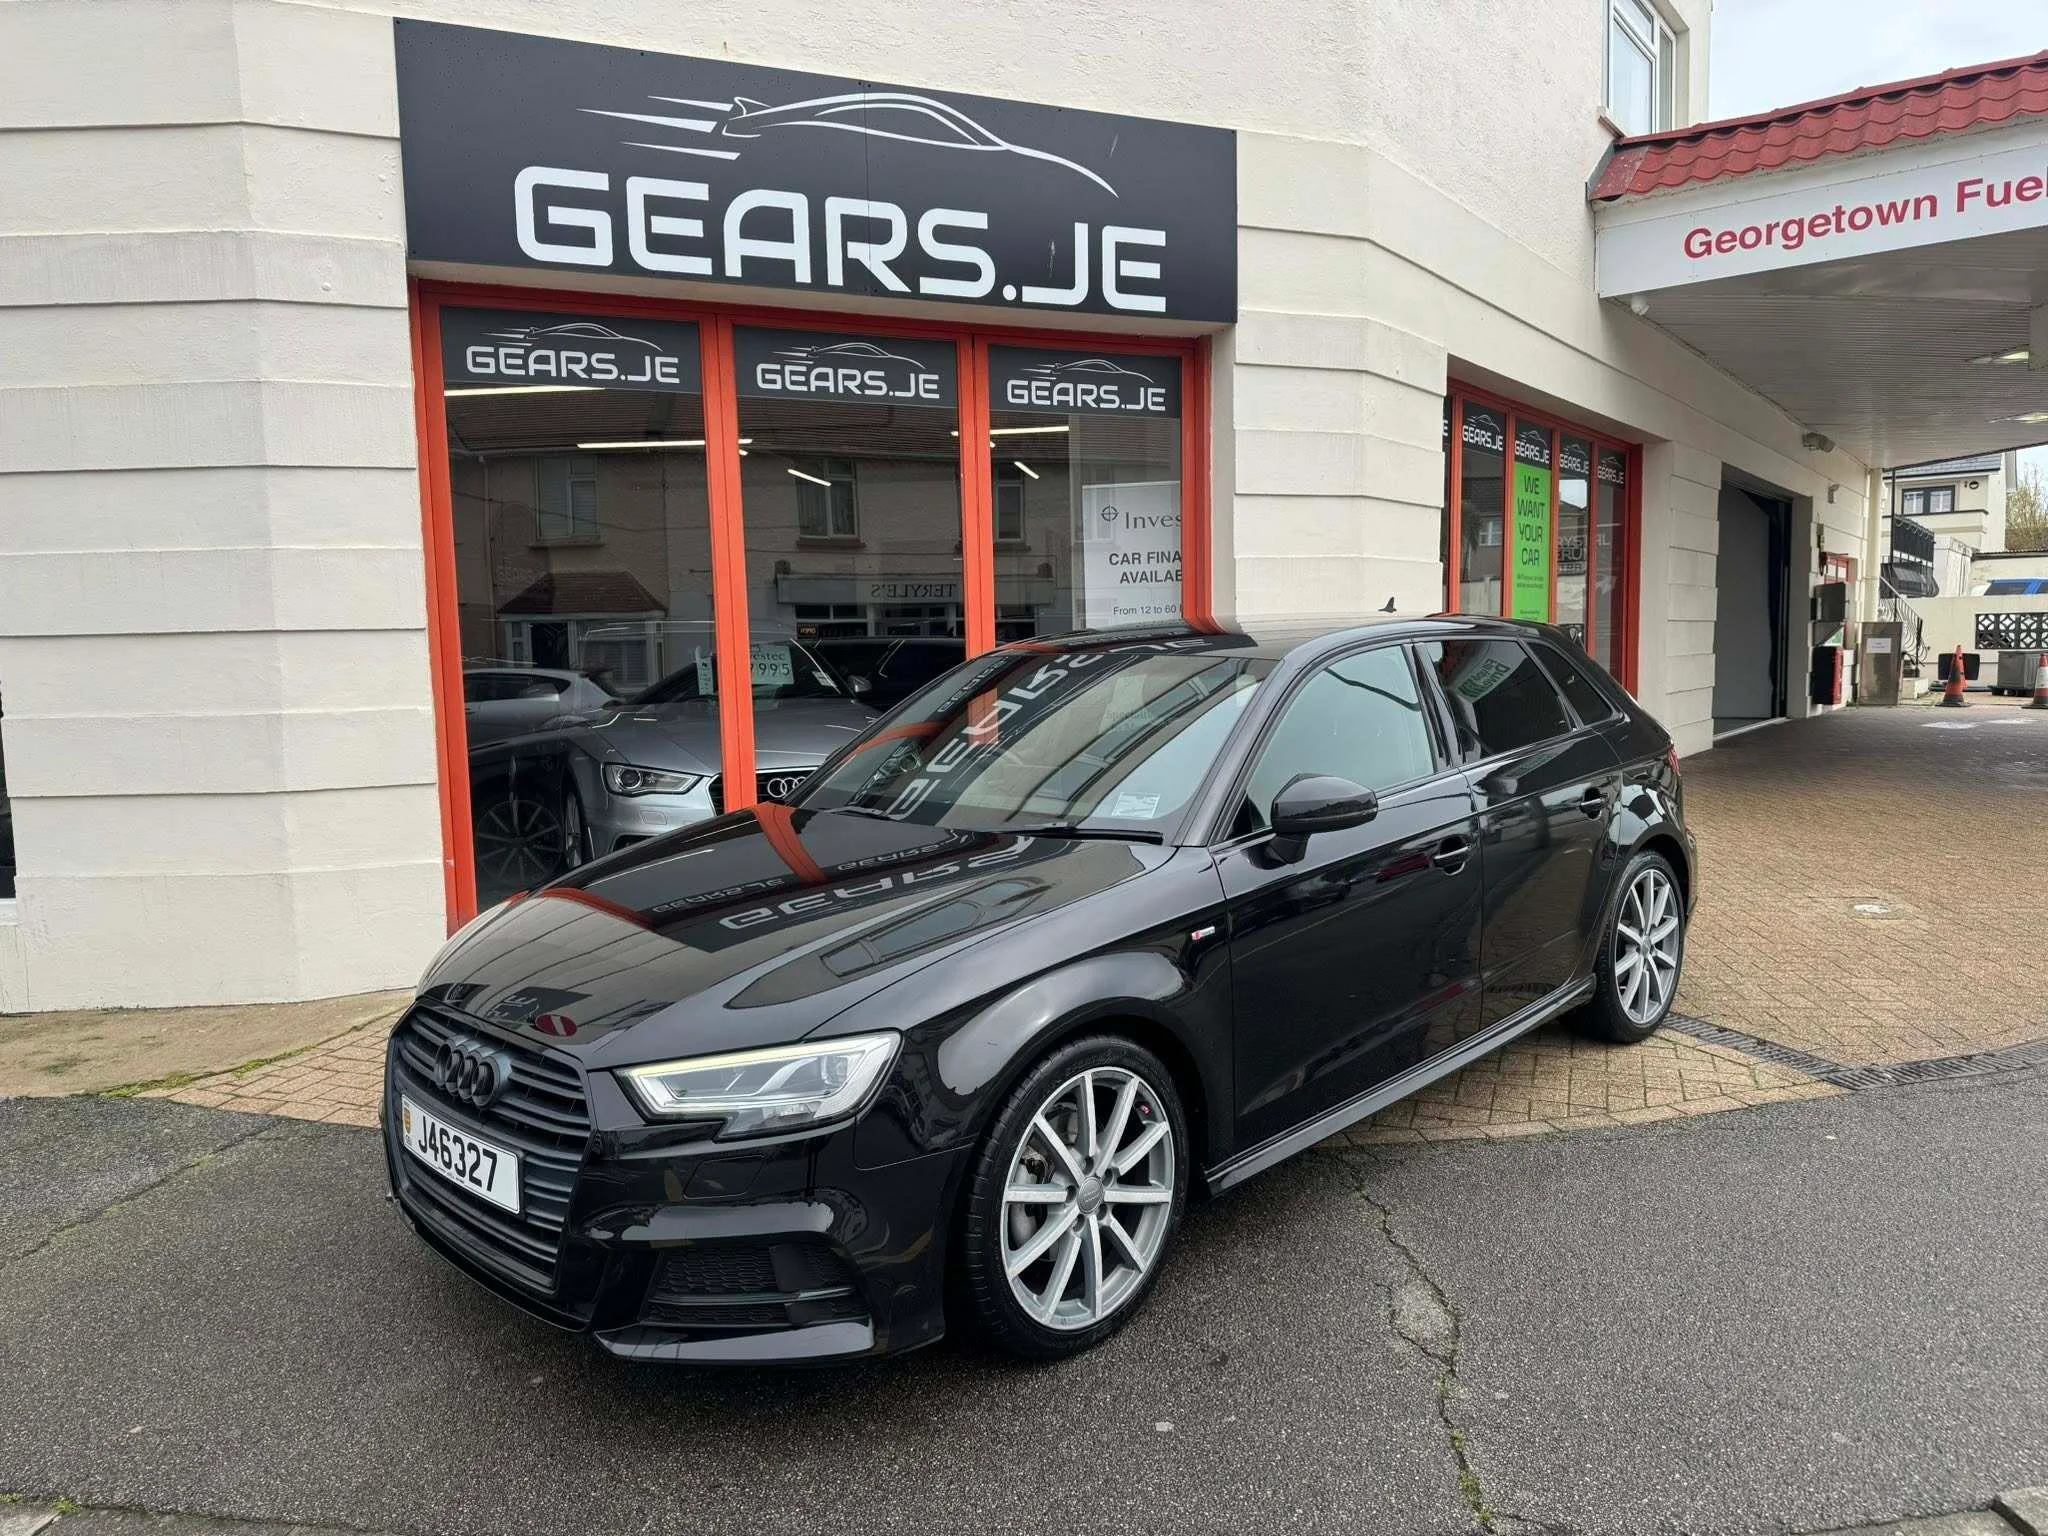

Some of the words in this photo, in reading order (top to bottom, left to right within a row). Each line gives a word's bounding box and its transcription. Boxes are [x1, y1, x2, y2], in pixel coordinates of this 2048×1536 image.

[514, 166, 1167, 312] GEARS.JE
[1684, 194, 1937, 259] Georgetown
[466, 345, 680, 384] GEARS.JE
[756, 363, 940, 399] GEARS.JE
[1007, 379, 1166, 411] GEARS.JE
[1524, 475, 1540, 495] WE
[1517, 496, 1545, 519] WANT
[1519, 523, 1543, 542] YOUR
[1109, 552, 1141, 566] CAR
[1521, 547, 1540, 568] CAR
[1113, 606, 1137, 616] From
[1140, 606, 1151, 614] 12
[1154, 606, 1163, 614] to
[1165, 605, 1177, 614] 60
[418, 1115, 497, 1193] J46327
